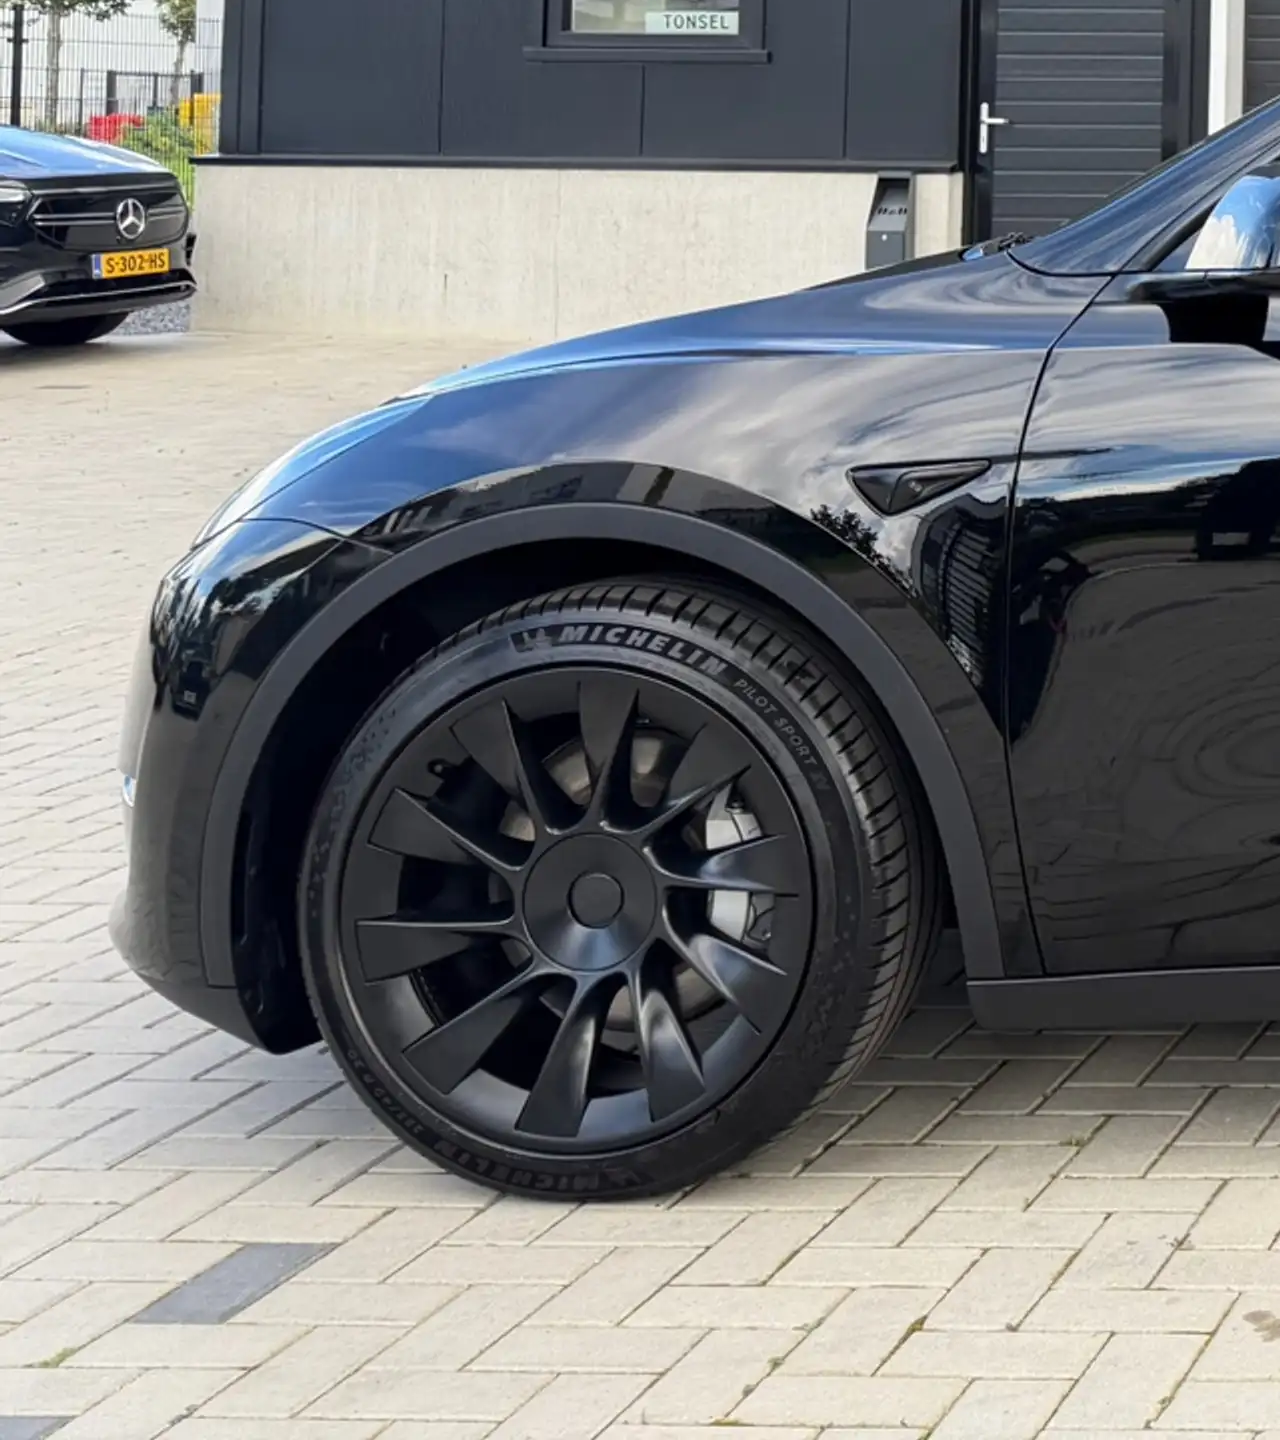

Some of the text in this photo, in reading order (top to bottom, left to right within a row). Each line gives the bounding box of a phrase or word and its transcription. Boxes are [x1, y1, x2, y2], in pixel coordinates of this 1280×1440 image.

[663, 14, 730, 30] TONSEL
[105, 252, 166, 274] S-302-HS
[558, 623, 729, 676] MICHELIN
[733, 678, 775, 715] PILOT
[773, 716, 819, 767] SPORT
